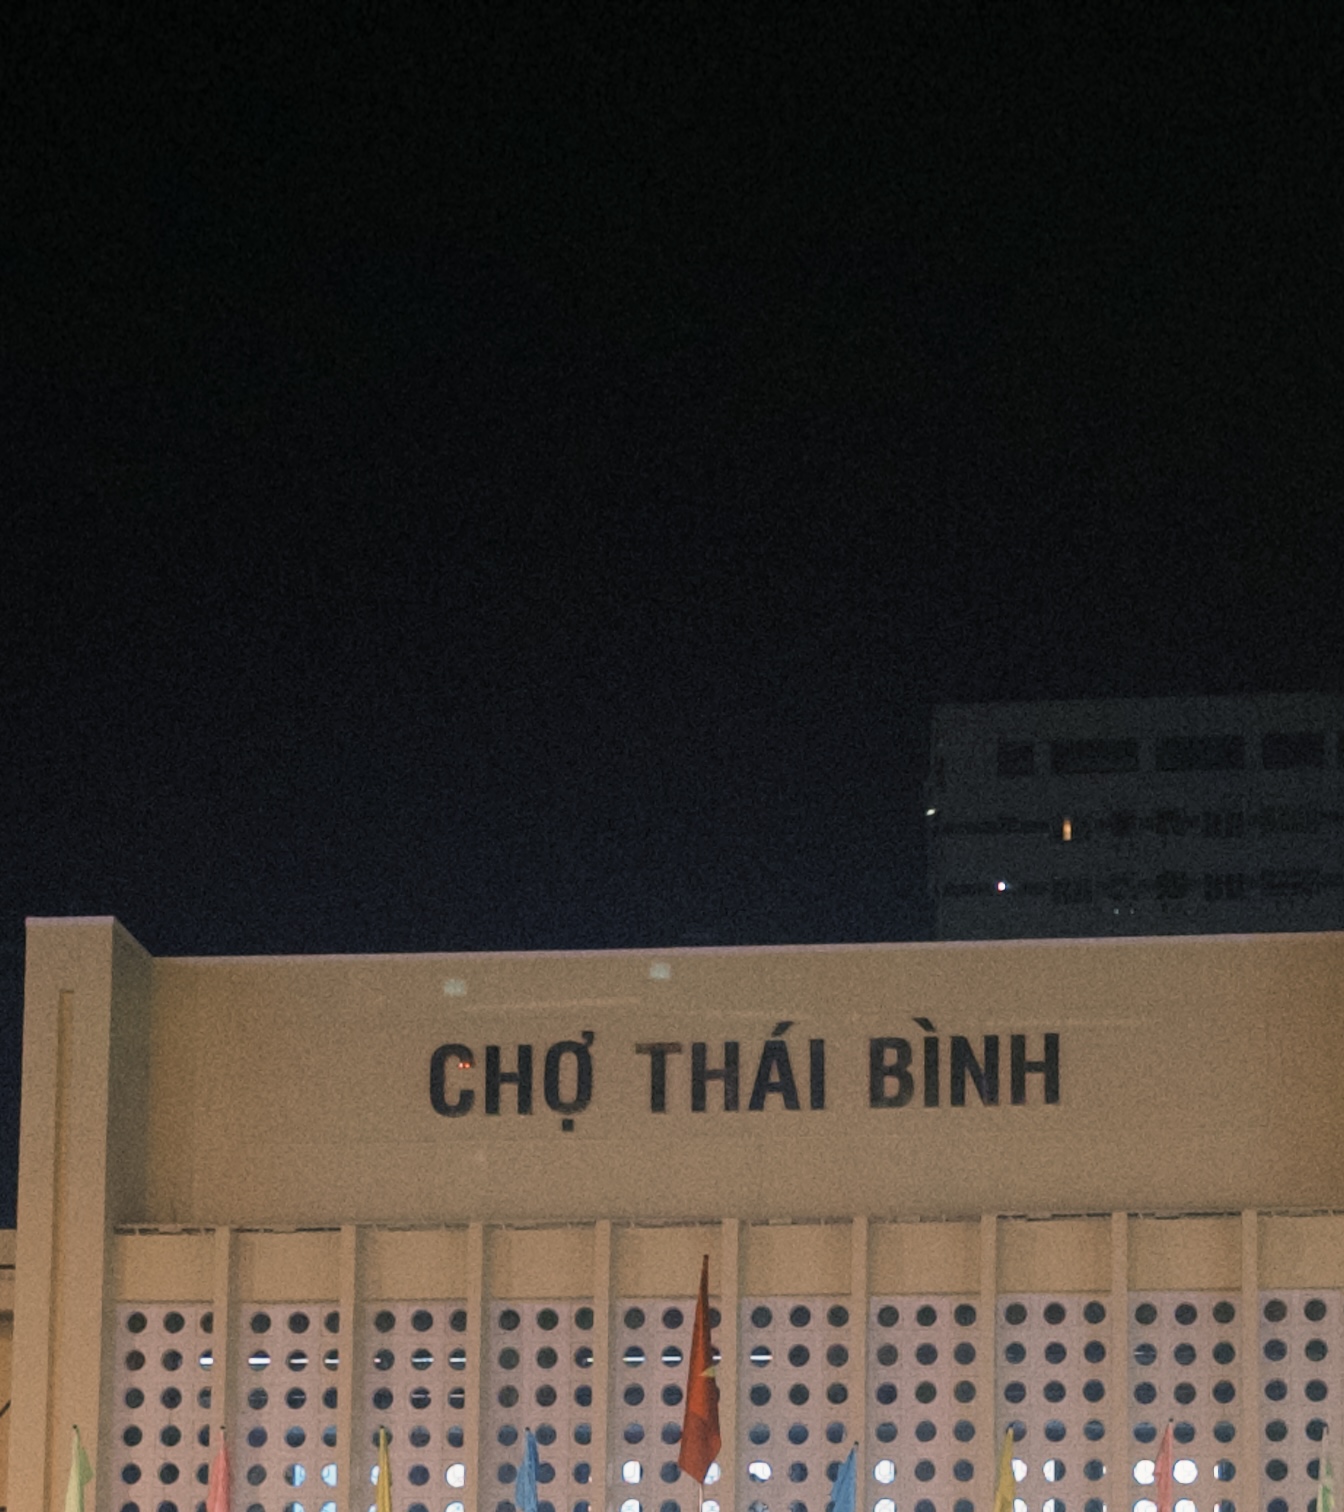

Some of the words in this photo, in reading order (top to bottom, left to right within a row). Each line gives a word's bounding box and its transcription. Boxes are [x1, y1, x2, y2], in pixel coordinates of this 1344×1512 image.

[429, 1030, 595, 1132] CHỢ
[635, 1021, 826, 1114] THÁI
[868, 1017, 1061, 1109] BÌNH
